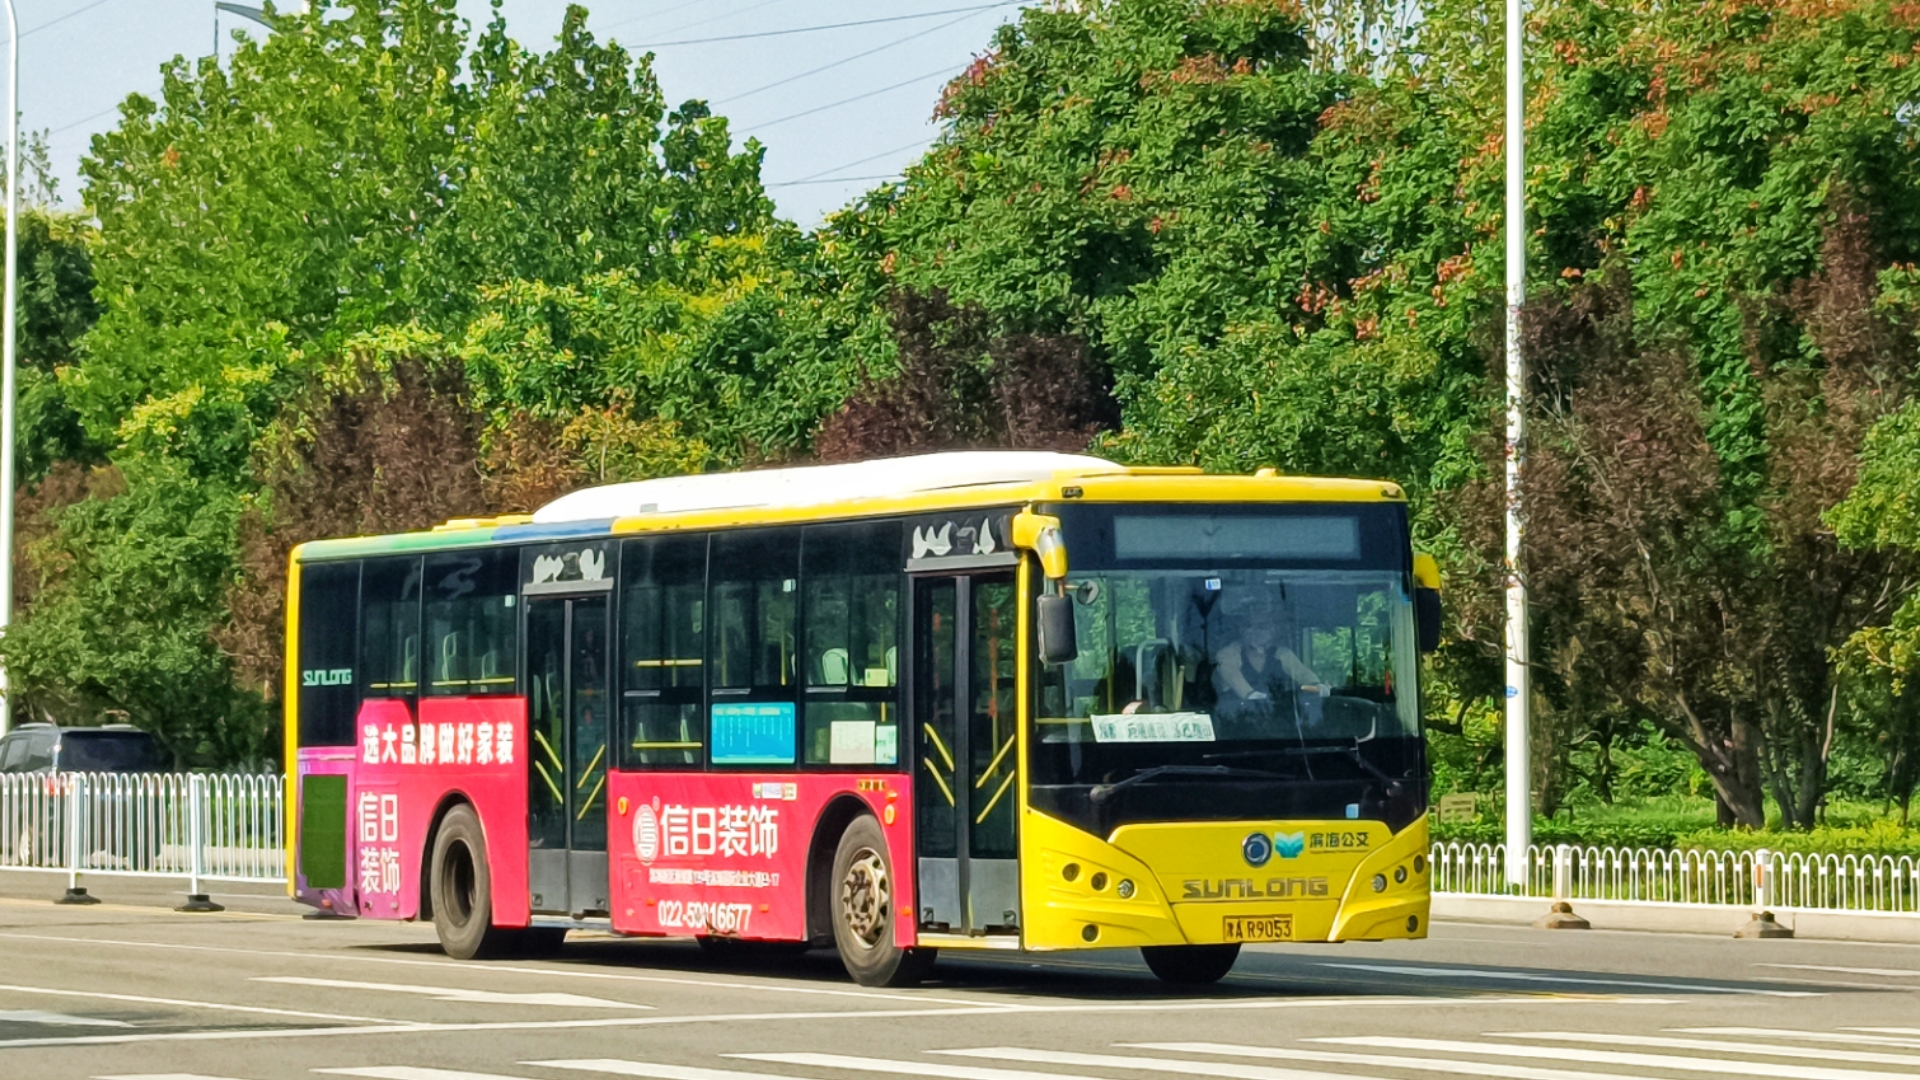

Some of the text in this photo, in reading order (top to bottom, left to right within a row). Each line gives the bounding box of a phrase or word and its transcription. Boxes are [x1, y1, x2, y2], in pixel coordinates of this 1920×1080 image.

[358, 792, 398, 843] 信日
[660, 804, 778, 859] 信日装饰
[361, 847, 400, 896] 装饰
[1182, 877, 1328, 899] SUNLONG
